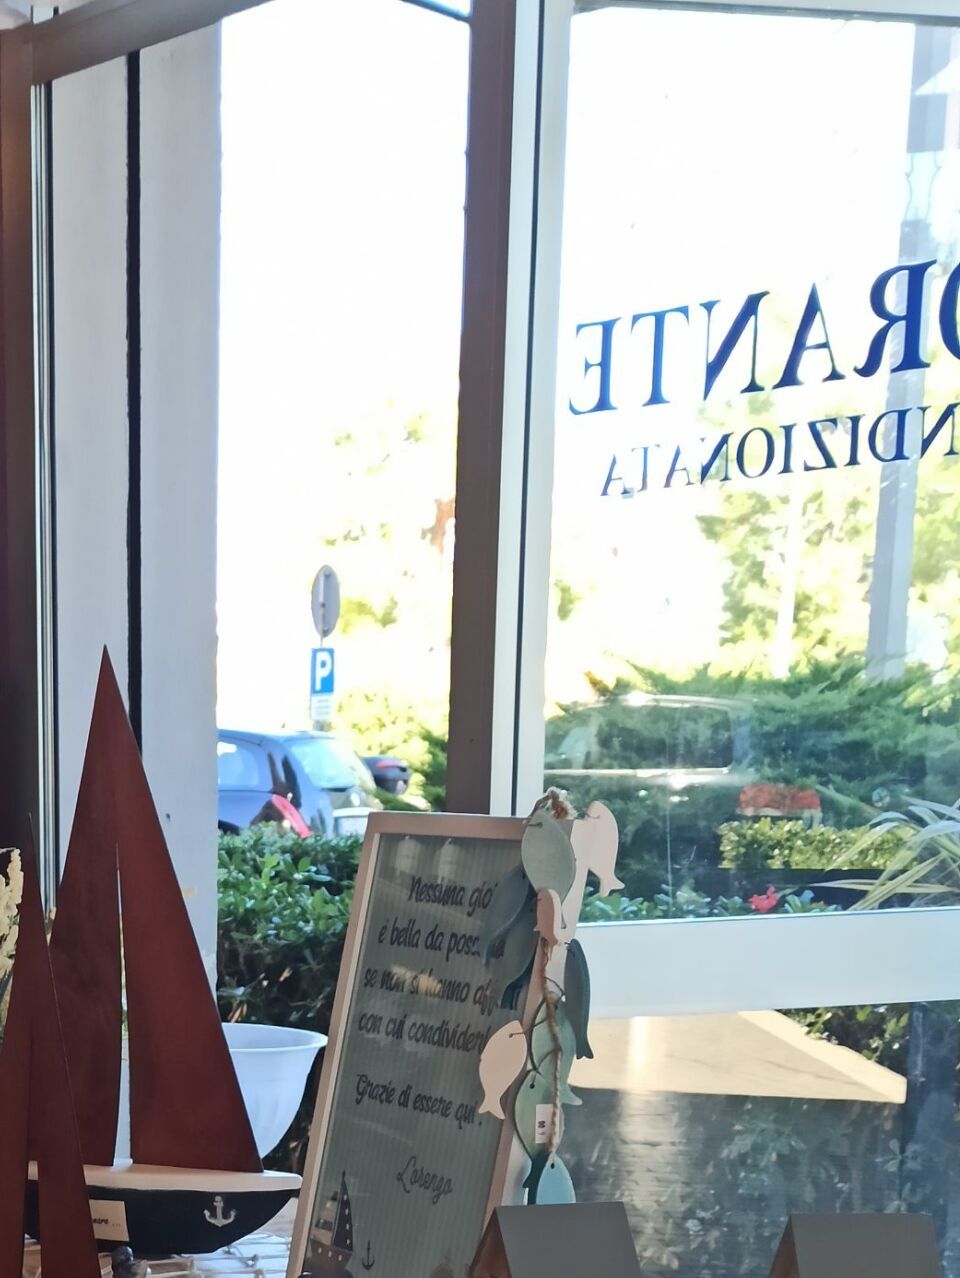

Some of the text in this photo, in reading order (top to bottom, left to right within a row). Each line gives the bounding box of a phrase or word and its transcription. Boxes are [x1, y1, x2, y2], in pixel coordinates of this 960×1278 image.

[315, 650, 332, 691] P
[407, 875, 464, 906] Nessuna
[390, 917, 421, 949] bella
[425, 923, 444, 951] da
[364, 968, 378, 988] se
[381, 970, 406, 992] non
[410, 969, 424, 994] si
[358, 1012, 381, 1035] con
[385, 1014, 407, 1040] cui
[355, 1073, 396, 1105] Grazie
[398, 1083, 413, 1109] di
[413, 1092, 453, 1119] essere
[396, 1155, 454, 1206] Lorenzo
